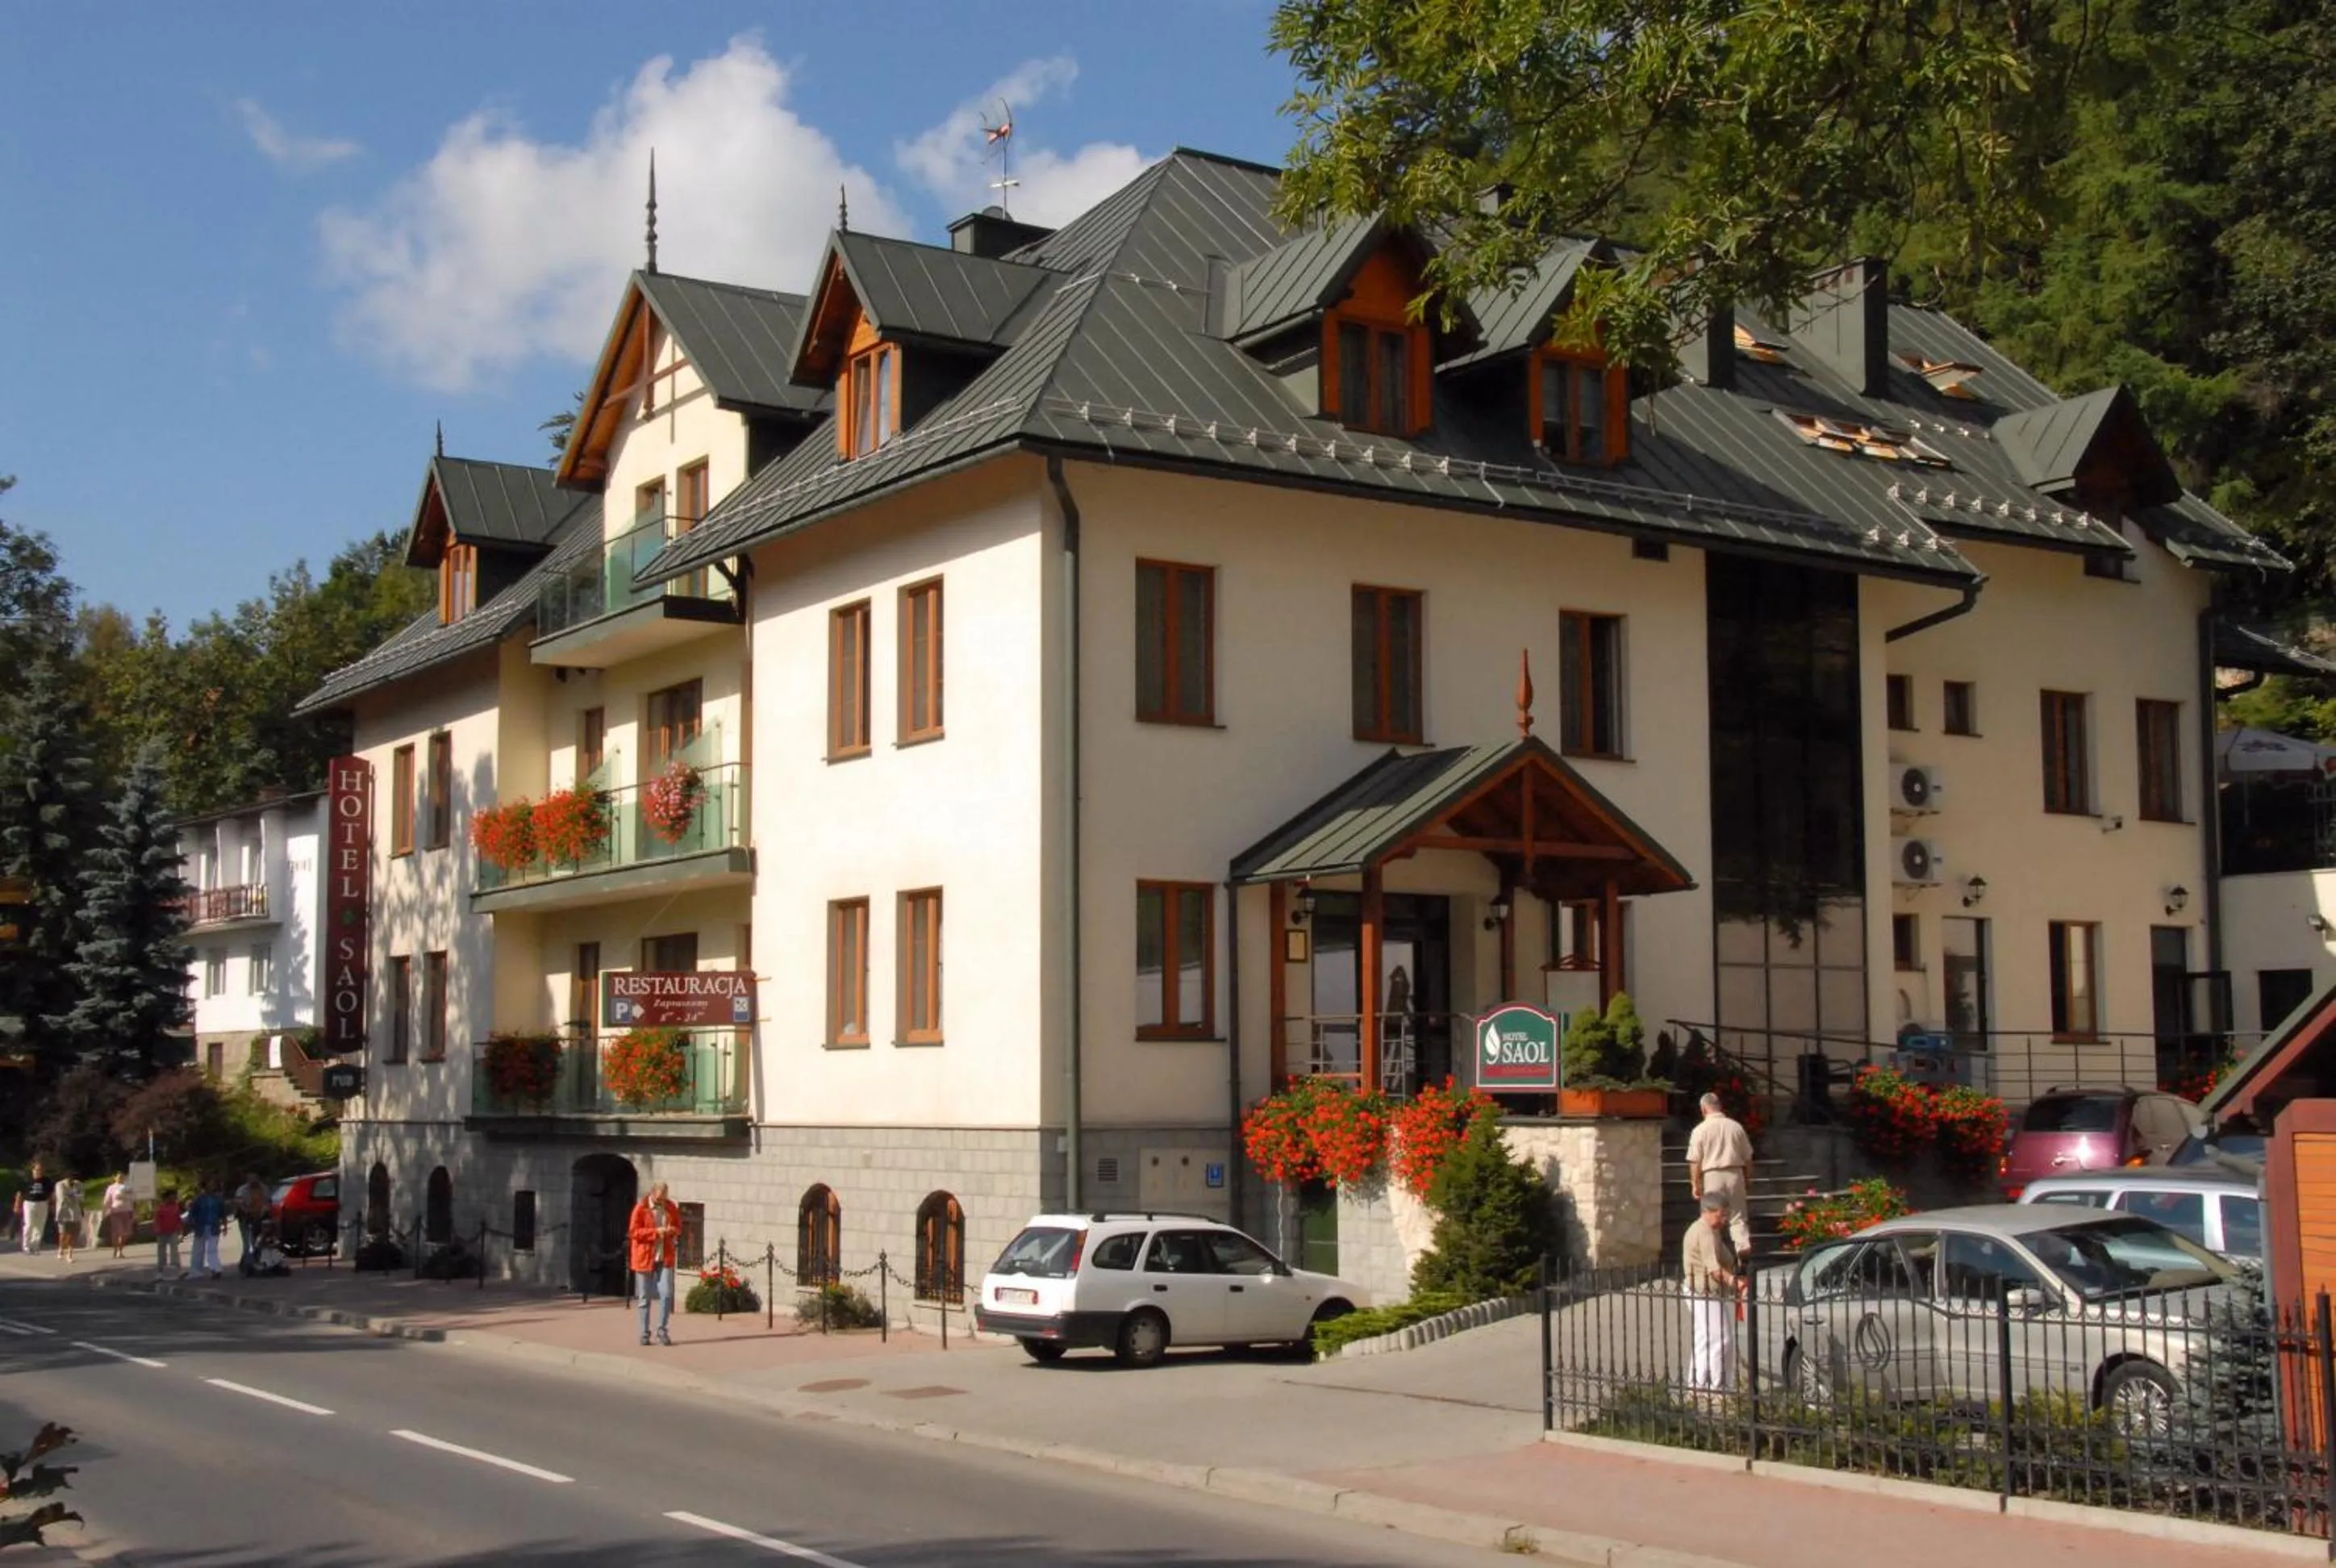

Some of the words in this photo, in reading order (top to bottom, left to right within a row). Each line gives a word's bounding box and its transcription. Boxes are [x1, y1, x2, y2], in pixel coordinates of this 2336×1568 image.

[338, 769, 364, 898] HOTEL
[335, 937, 358, 1040] SAOL
[614, 976, 747, 999] RESTAURACJA
[615, 1003, 628, 1020] P
[1501, 1041, 1550, 1064] SAOL
